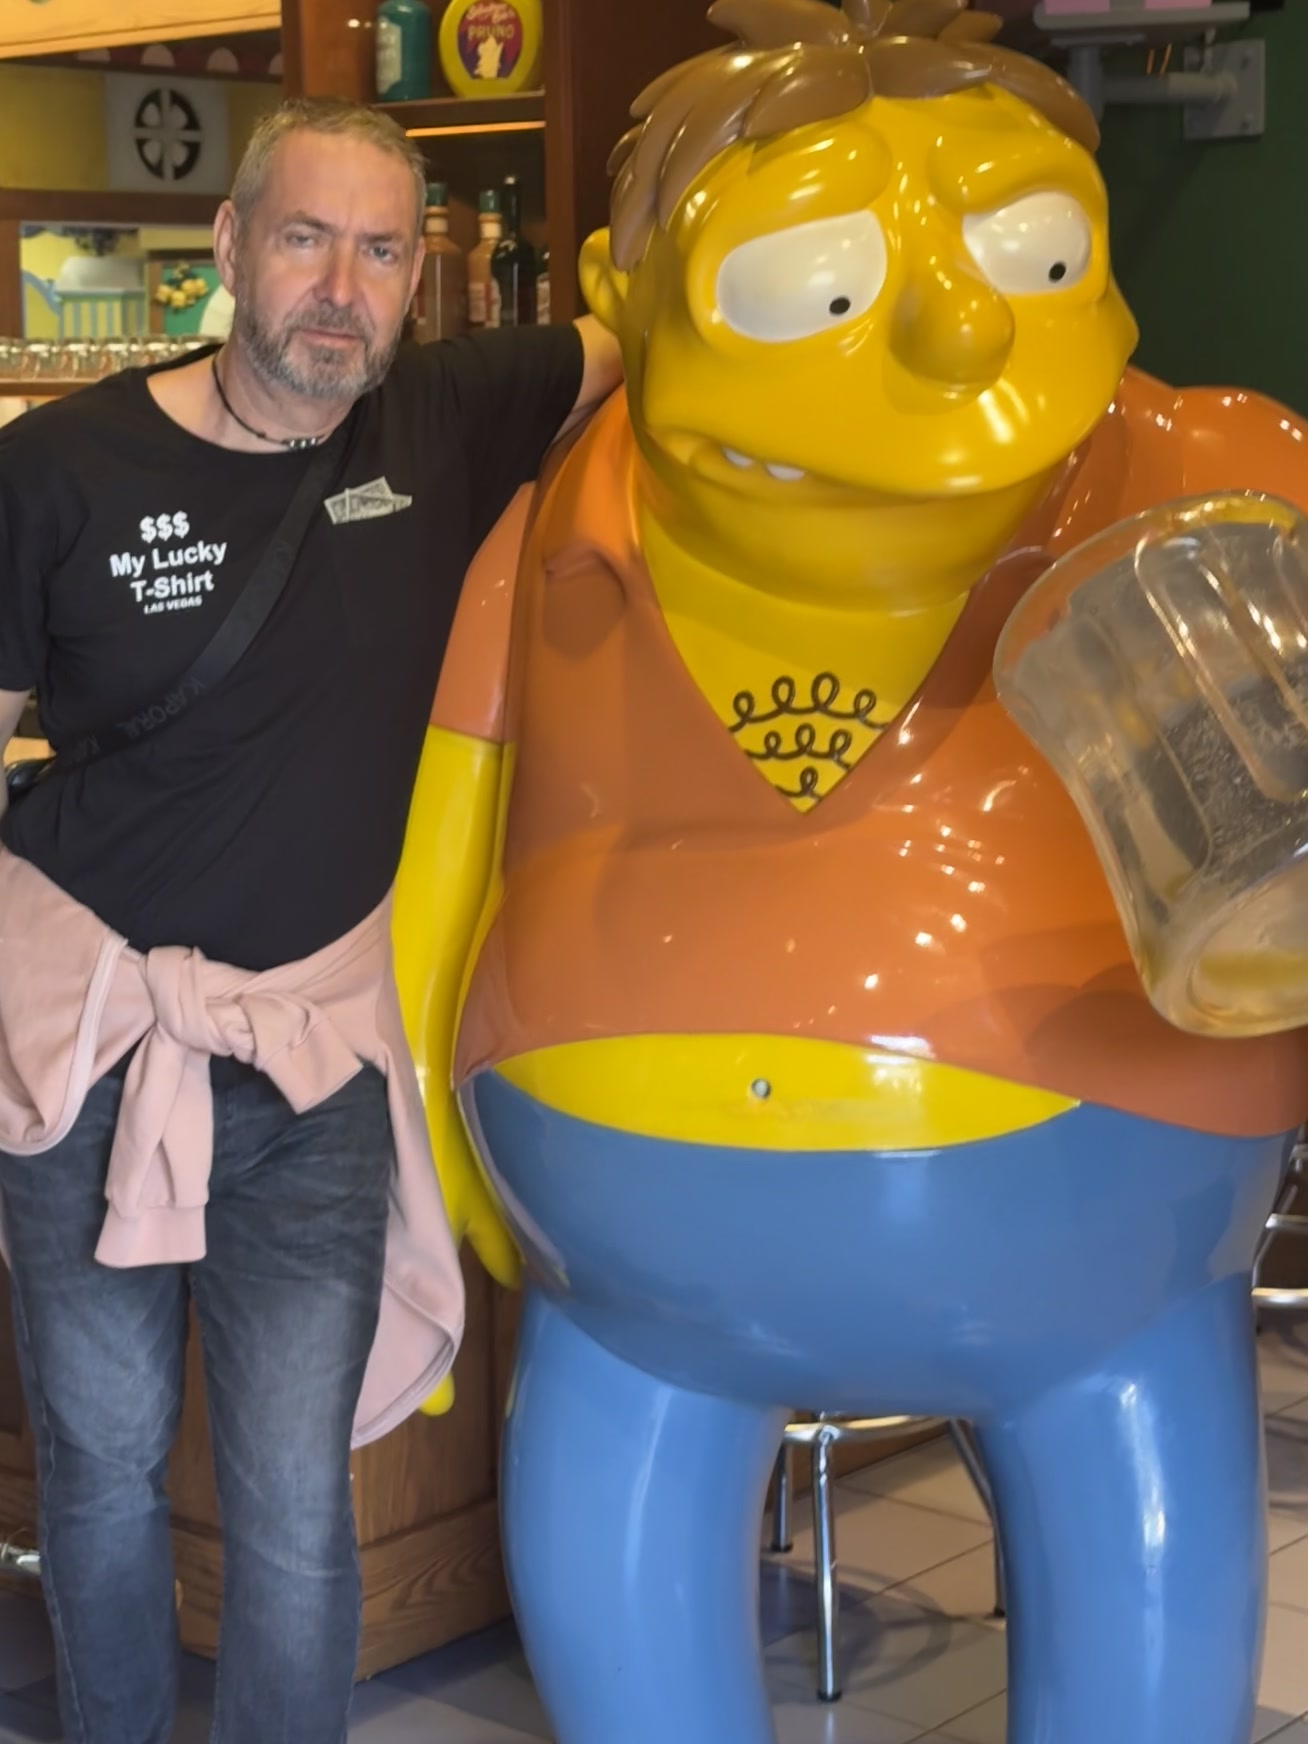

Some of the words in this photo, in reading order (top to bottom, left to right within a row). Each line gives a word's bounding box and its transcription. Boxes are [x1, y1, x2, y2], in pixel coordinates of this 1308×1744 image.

[139, 510, 190, 543] $$$
[109, 551, 145, 578] My
[152, 540, 227, 565] Lucky
[130, 570, 215, 602] T-Shirt
[144, 602, 164, 615] LAS
[166, 595, 202, 610] VEGAS
